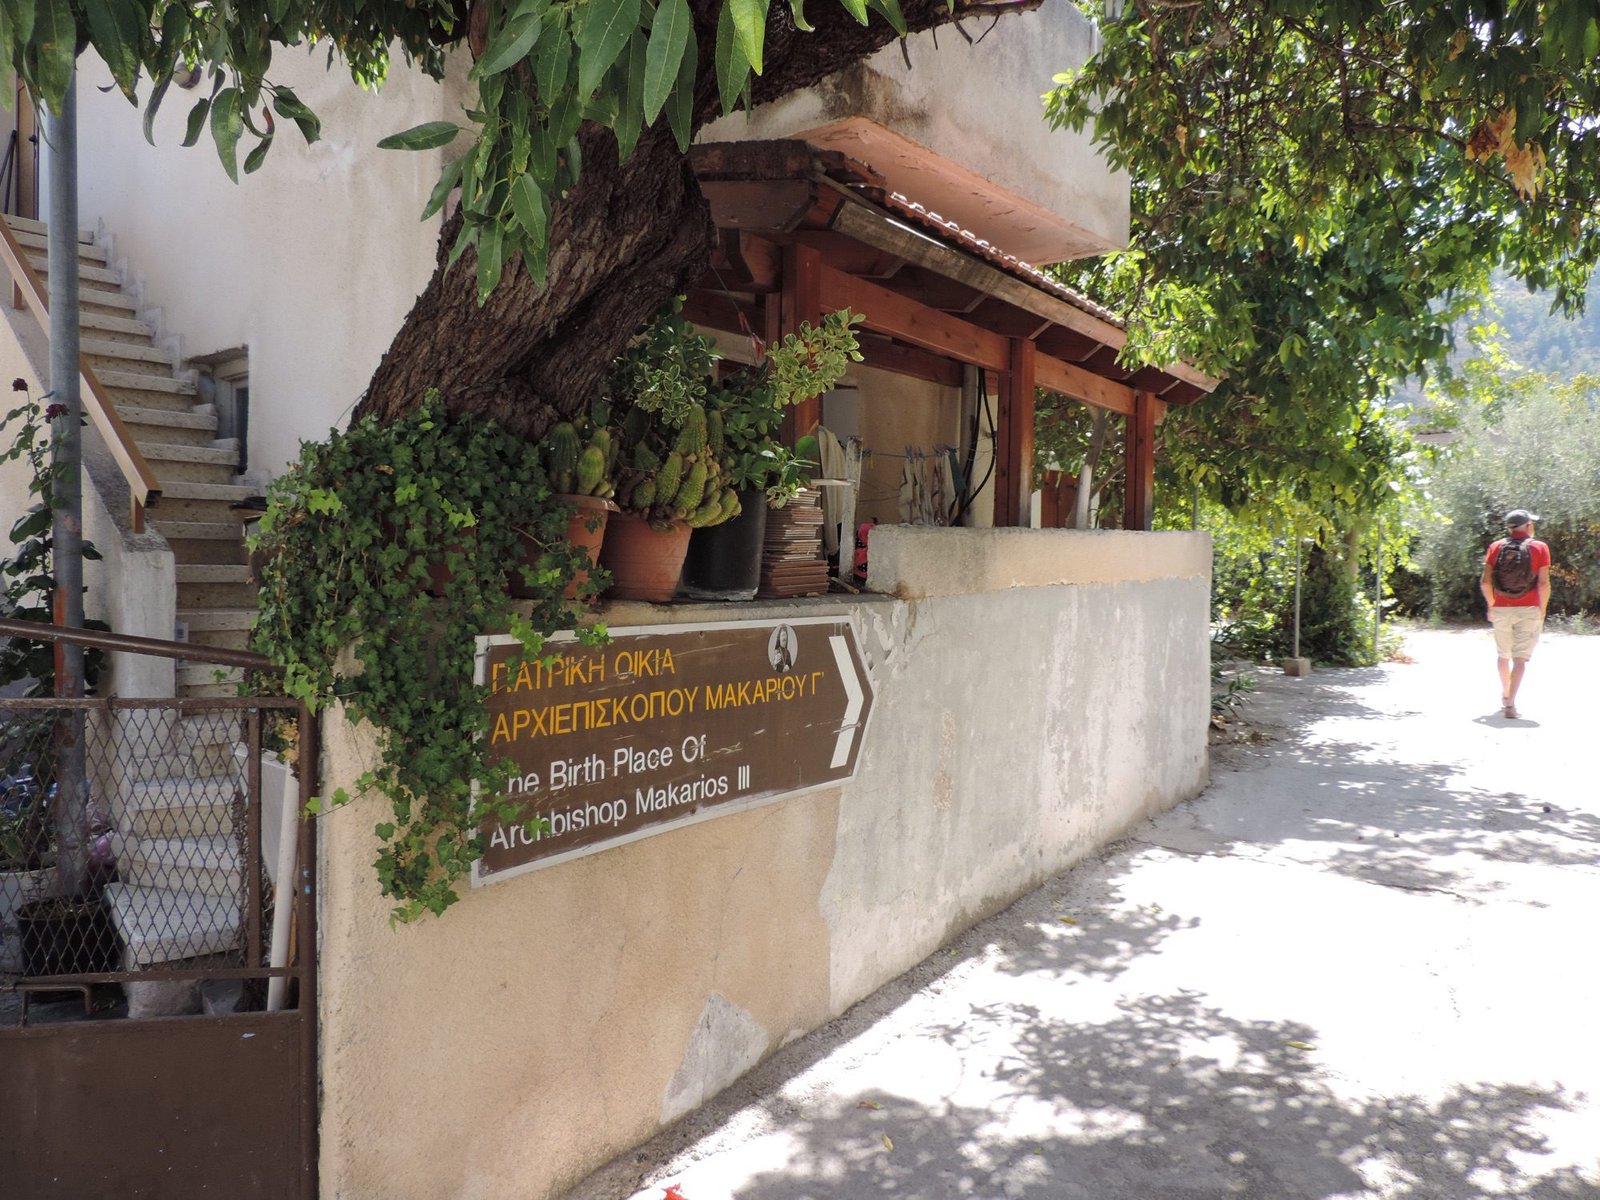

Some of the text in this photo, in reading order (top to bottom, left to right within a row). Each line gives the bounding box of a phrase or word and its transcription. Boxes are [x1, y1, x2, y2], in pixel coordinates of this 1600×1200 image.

[614, 648, 676, 680] ΟΙΚΙΑ
[490, 686, 699, 745] ΑΡΧΙΕΠΙΣΚΟΠΟΥ
[705, 674, 807, 711] ΜΑΚΑΡΙΟΥ
[494, 734, 707, 797] he Birth Place Of
[635, 773, 729, 815] Makarios
[737, 764, 750, 791] III
